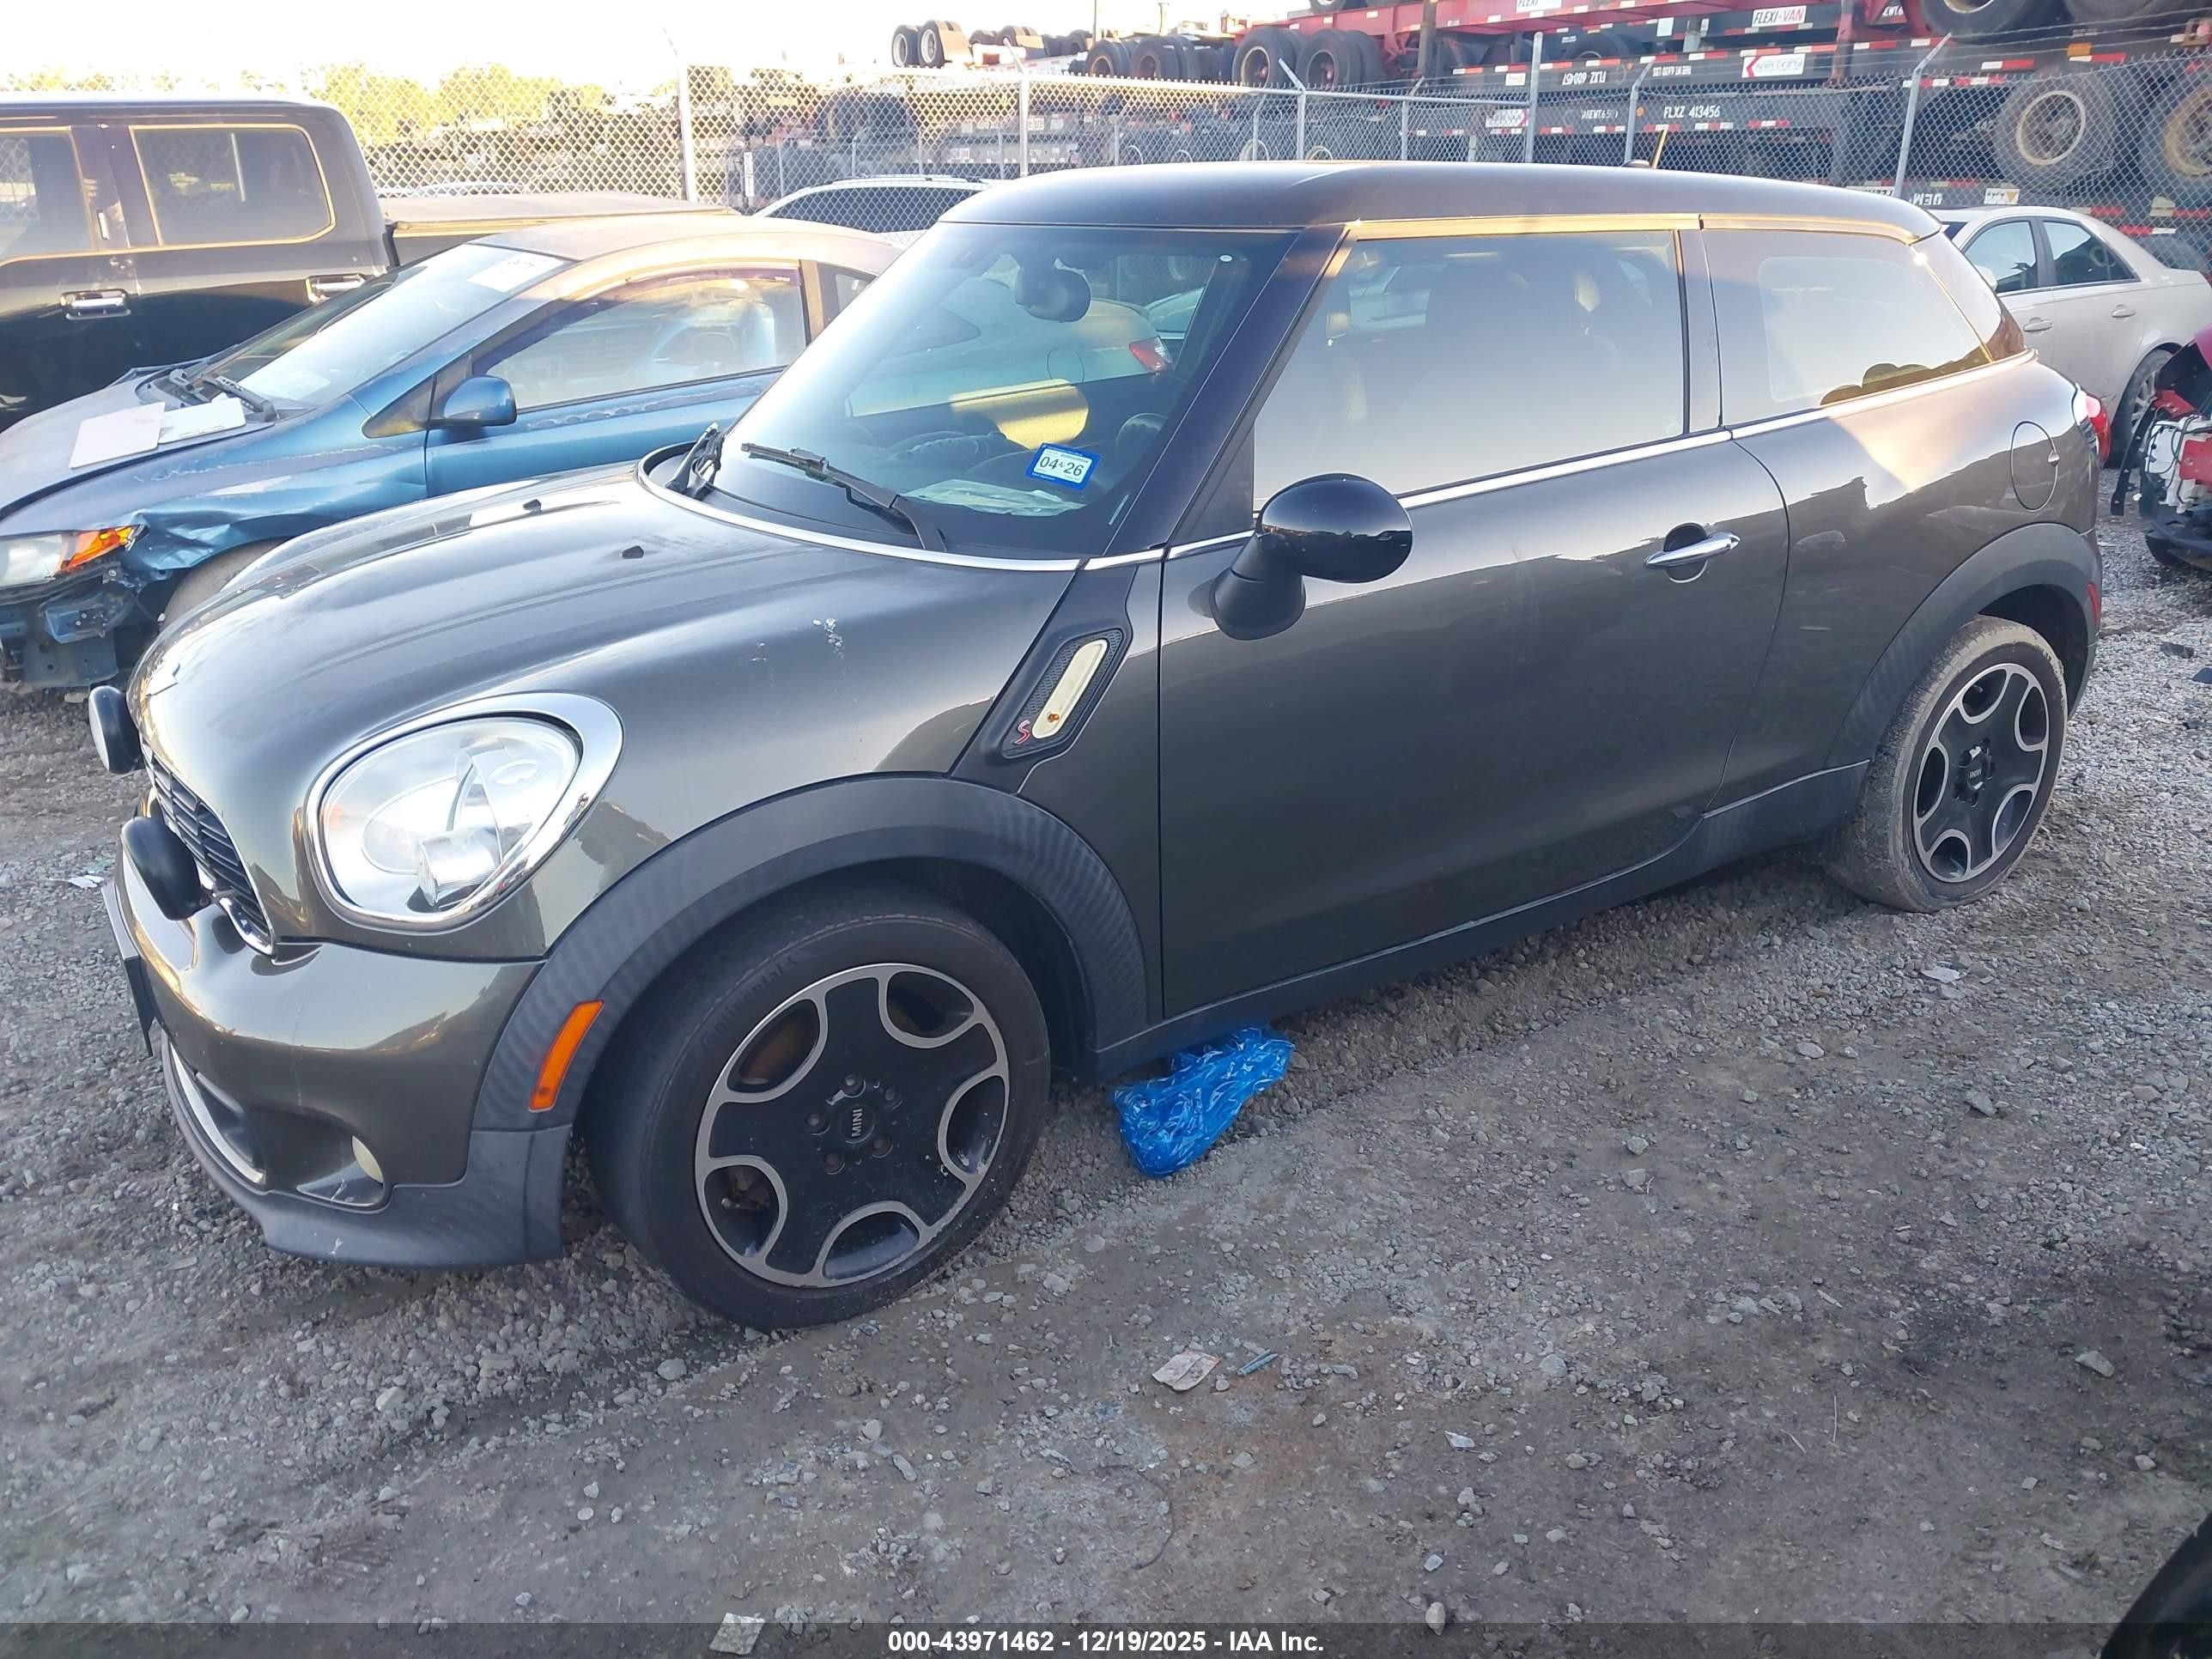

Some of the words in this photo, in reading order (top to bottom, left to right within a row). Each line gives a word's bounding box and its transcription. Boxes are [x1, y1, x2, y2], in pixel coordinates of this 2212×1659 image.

[1662, 105, 1686, 118] FLXZ
[1687, 104, 1721, 118] 413456
[1012, 719, 1031, 745] S
[851, 1108, 863, 1138] MINI
